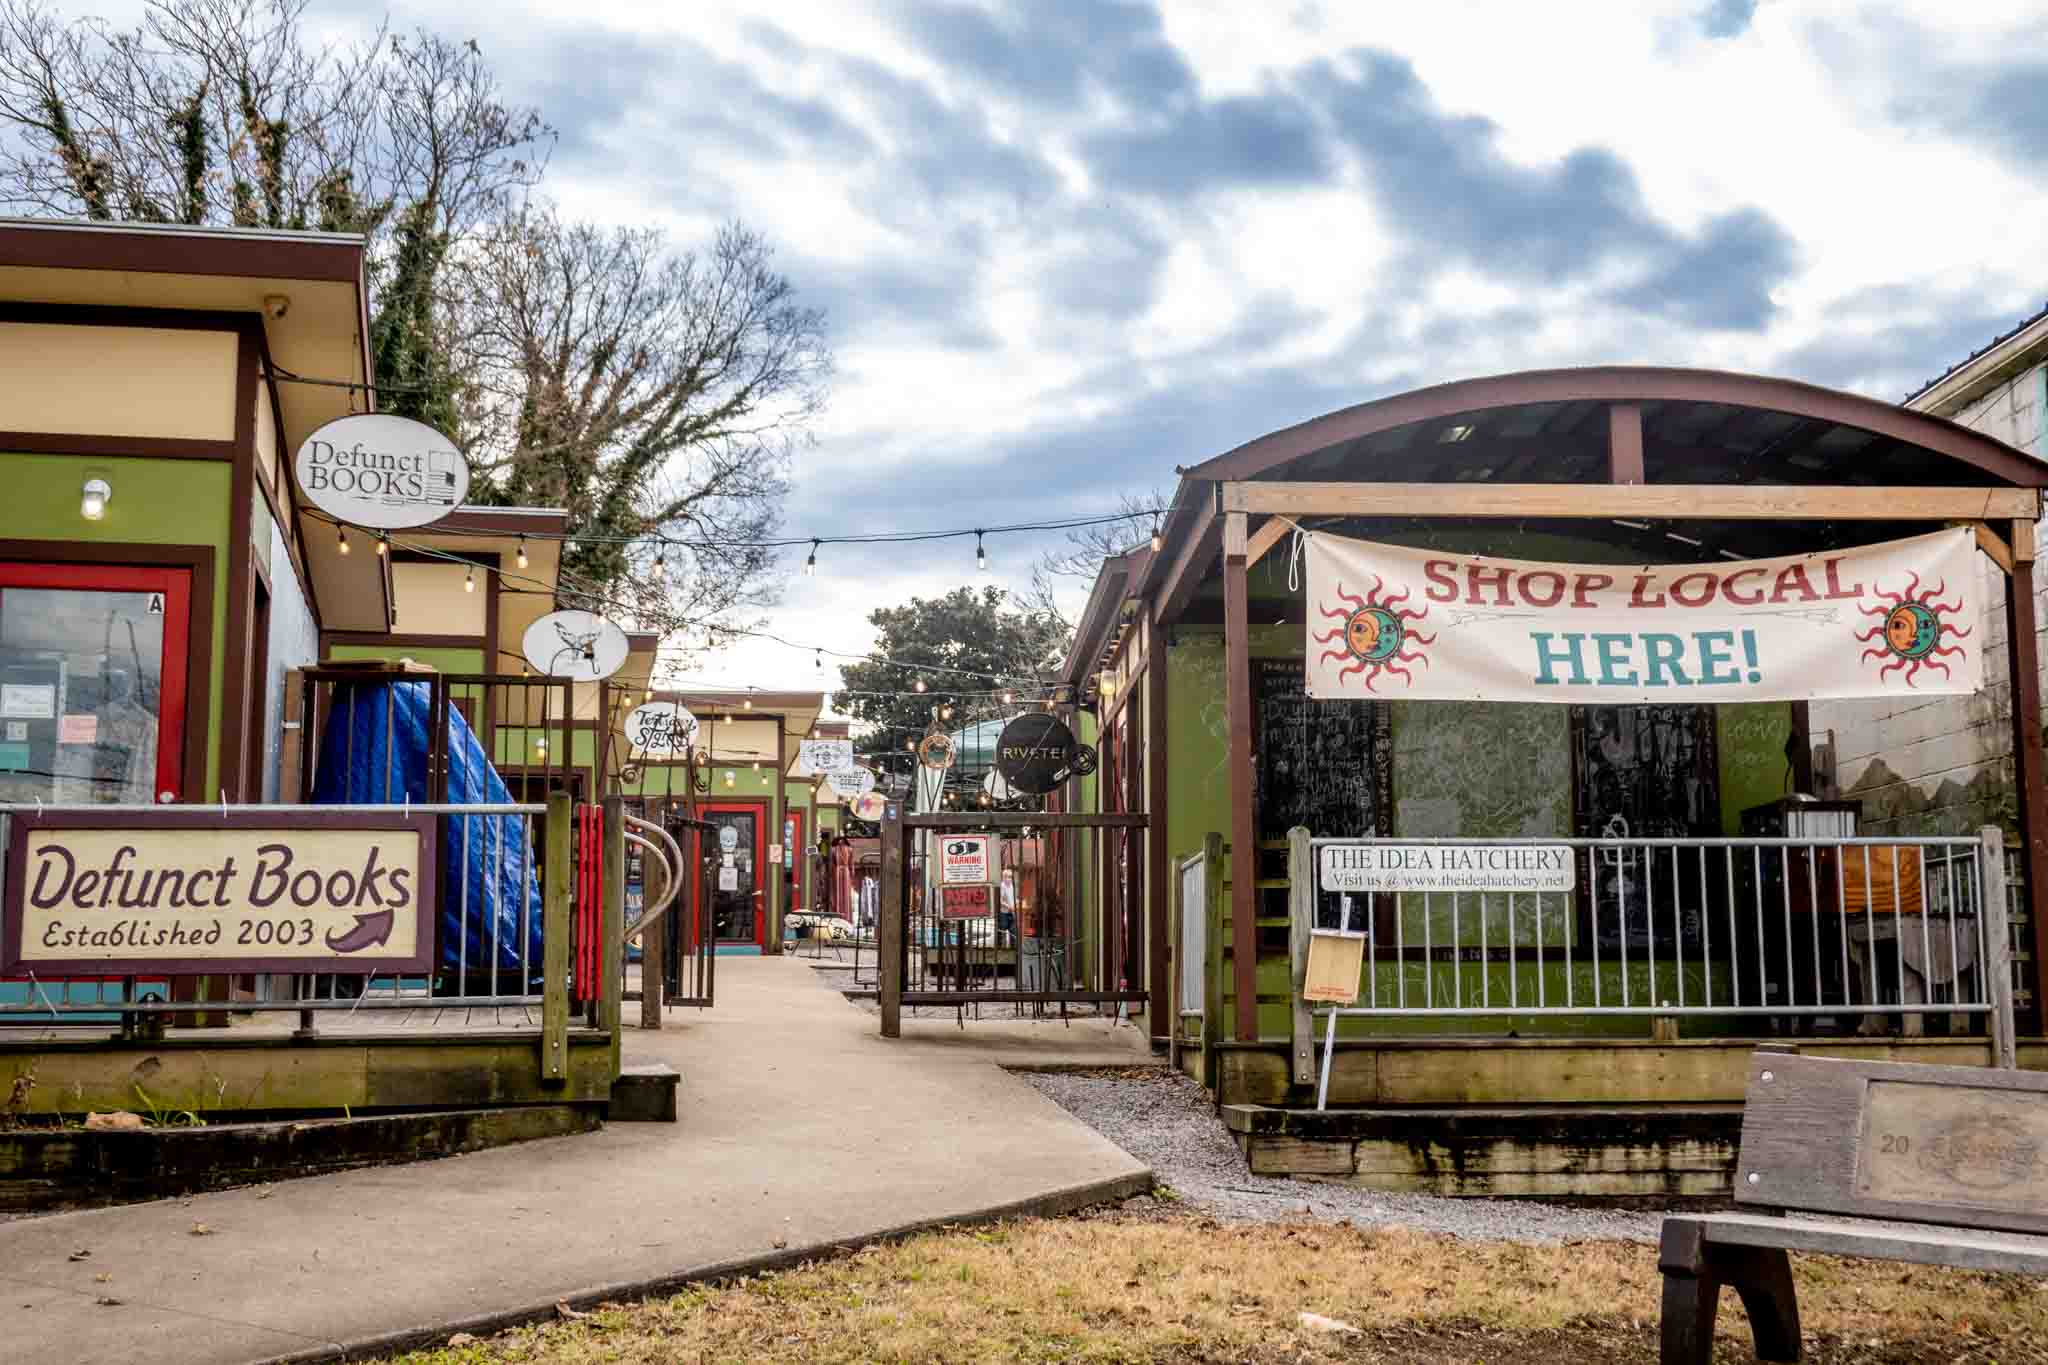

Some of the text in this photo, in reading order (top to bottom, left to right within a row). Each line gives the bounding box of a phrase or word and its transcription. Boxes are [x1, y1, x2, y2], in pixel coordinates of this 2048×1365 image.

[309, 440, 424, 473] Defunct
[309, 465, 423, 497] BOOKS
[1423, 556, 1865, 609] SHOP LOCAL
[149, 594, 163, 613] A
[1529, 629, 1762, 687] HERE!
[947, 856, 982, 865] WARNING
[1327, 848, 1567, 871] THE IDEA HATCHERY
[29, 843, 412, 910] Defunct Books
[1333, 872, 1363, 887] Visit
[1367, 877, 1383, 887] us
[1404, 872, 1565, 889] www.theideahatchery.net
[42, 918, 314, 948] Established 2003
